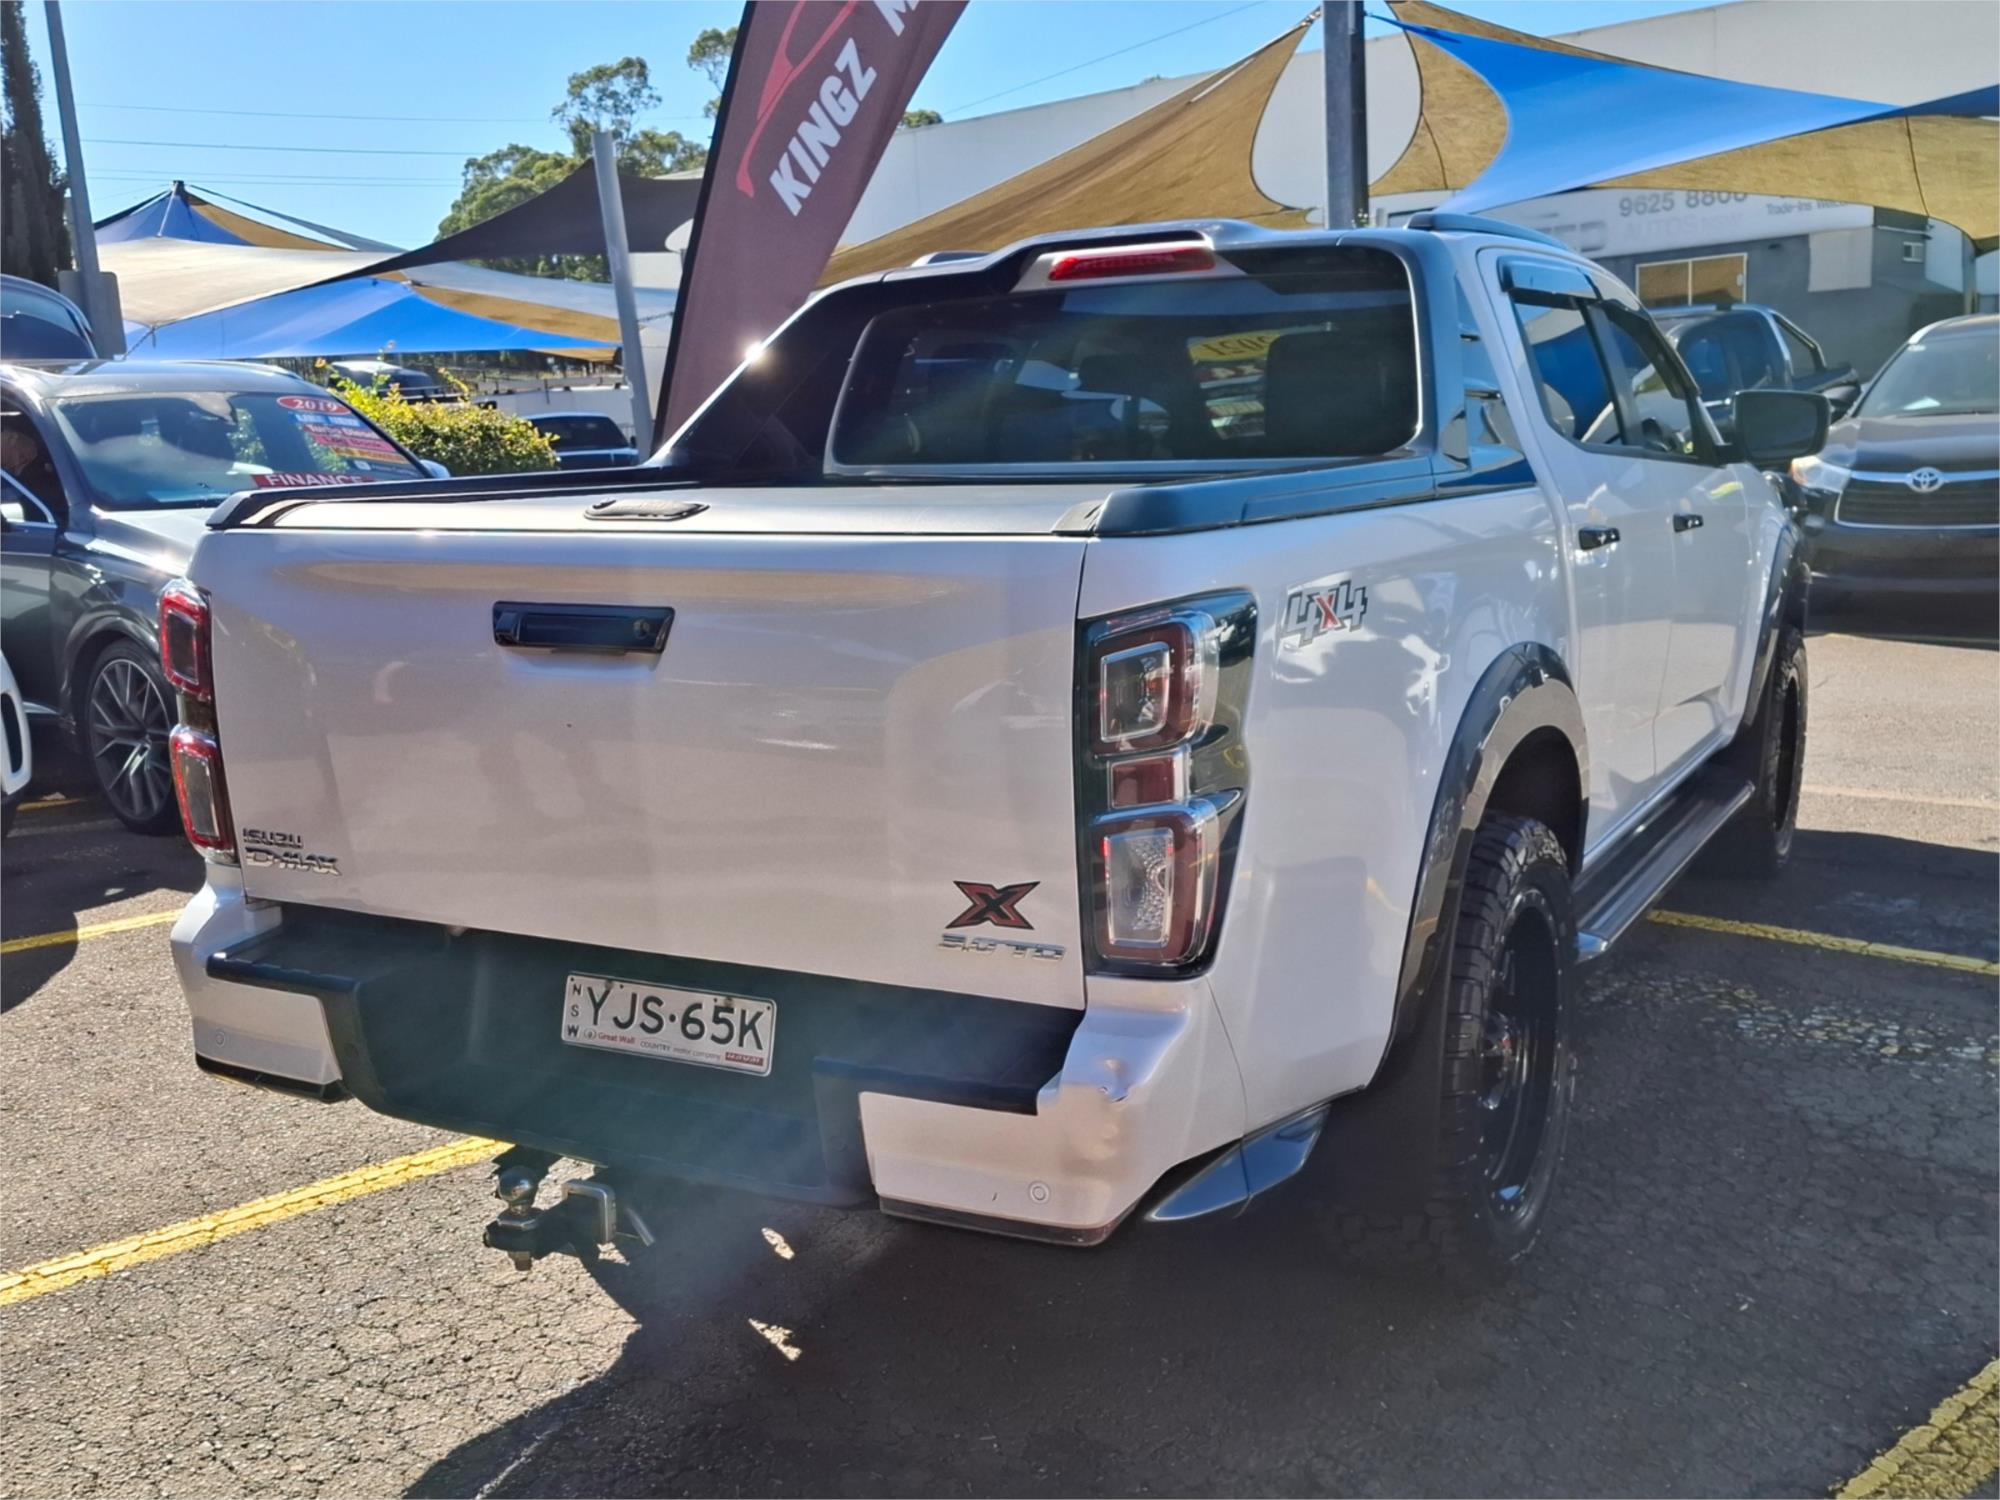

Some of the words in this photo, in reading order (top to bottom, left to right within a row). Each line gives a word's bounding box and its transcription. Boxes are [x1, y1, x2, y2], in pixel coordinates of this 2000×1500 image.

[769, 37, 877, 216] KINGZ
[1619, 191, 1675, 217] 9625
[295, 398, 337, 412] 2019
[265, 474, 363, 486] FINANCE
[243, 828, 304, 849] ISUZU
[945, 880, 1041, 930] X
[598, 1031, 618, 1042] Great
[620, 1034, 636, 1045] Wall
